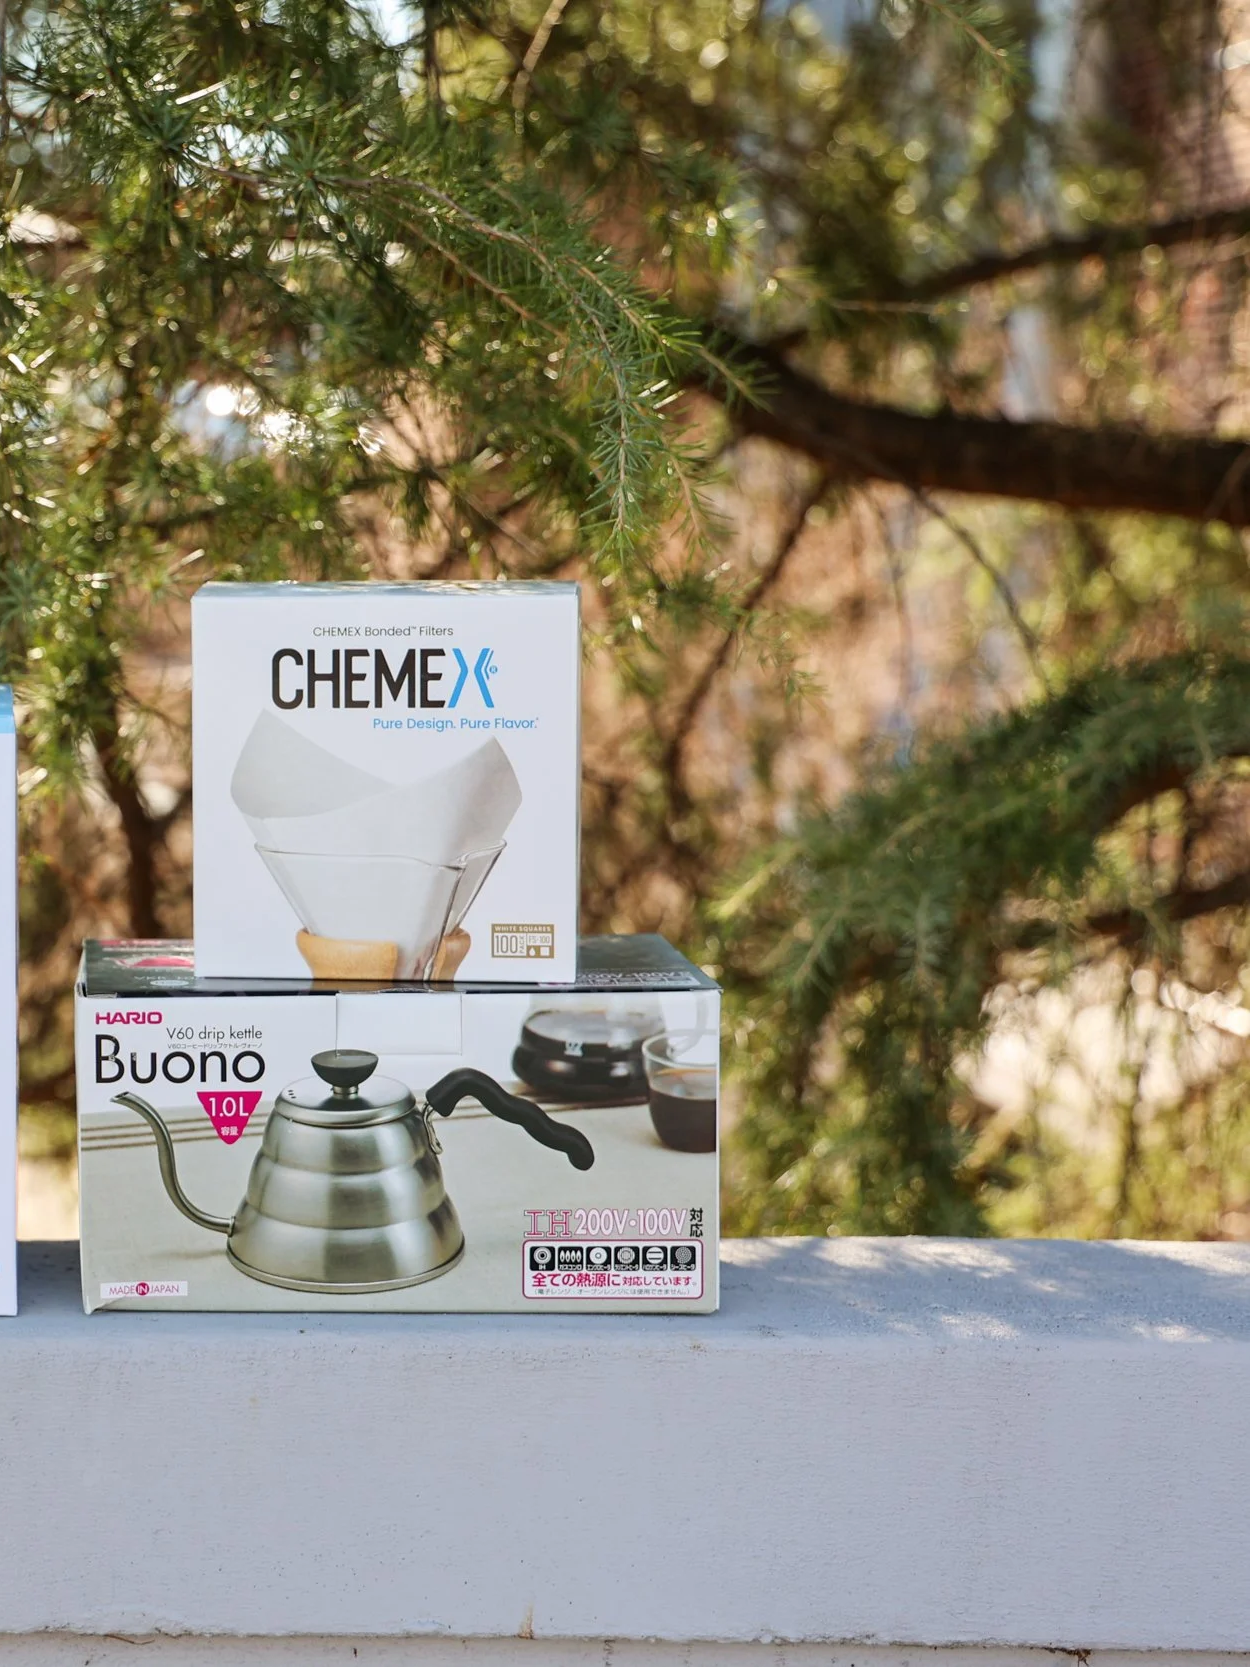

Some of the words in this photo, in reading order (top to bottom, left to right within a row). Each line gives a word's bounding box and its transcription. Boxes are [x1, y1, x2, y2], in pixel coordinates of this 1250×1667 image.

[312, 626, 361, 636] CHEMEX
[419, 625, 454, 636] Filters
[373, 718, 403, 729] Pure
[406, 717, 456, 732] Design.
[460, 718, 490, 729] Pure
[495, 934, 518, 954] 100
[95, 1011, 163, 1025] HARIO
[166, 1027, 194, 1040] V60
[198, 1025, 225, 1042] drip
[229, 1025, 263, 1039] kettle
[95, 1033, 266, 1084] Buono
[208, 1096, 249, 1117] 1.0L
[220, 1126, 239, 1136] 容量
[523, 1209, 572, 1238] IH
[689, 1207, 704, 1238] 対応
[109, 1285, 136, 1295] MADE
[137, 1284, 148, 1294] IN
[150, 1284, 180, 1293] JAPAN
